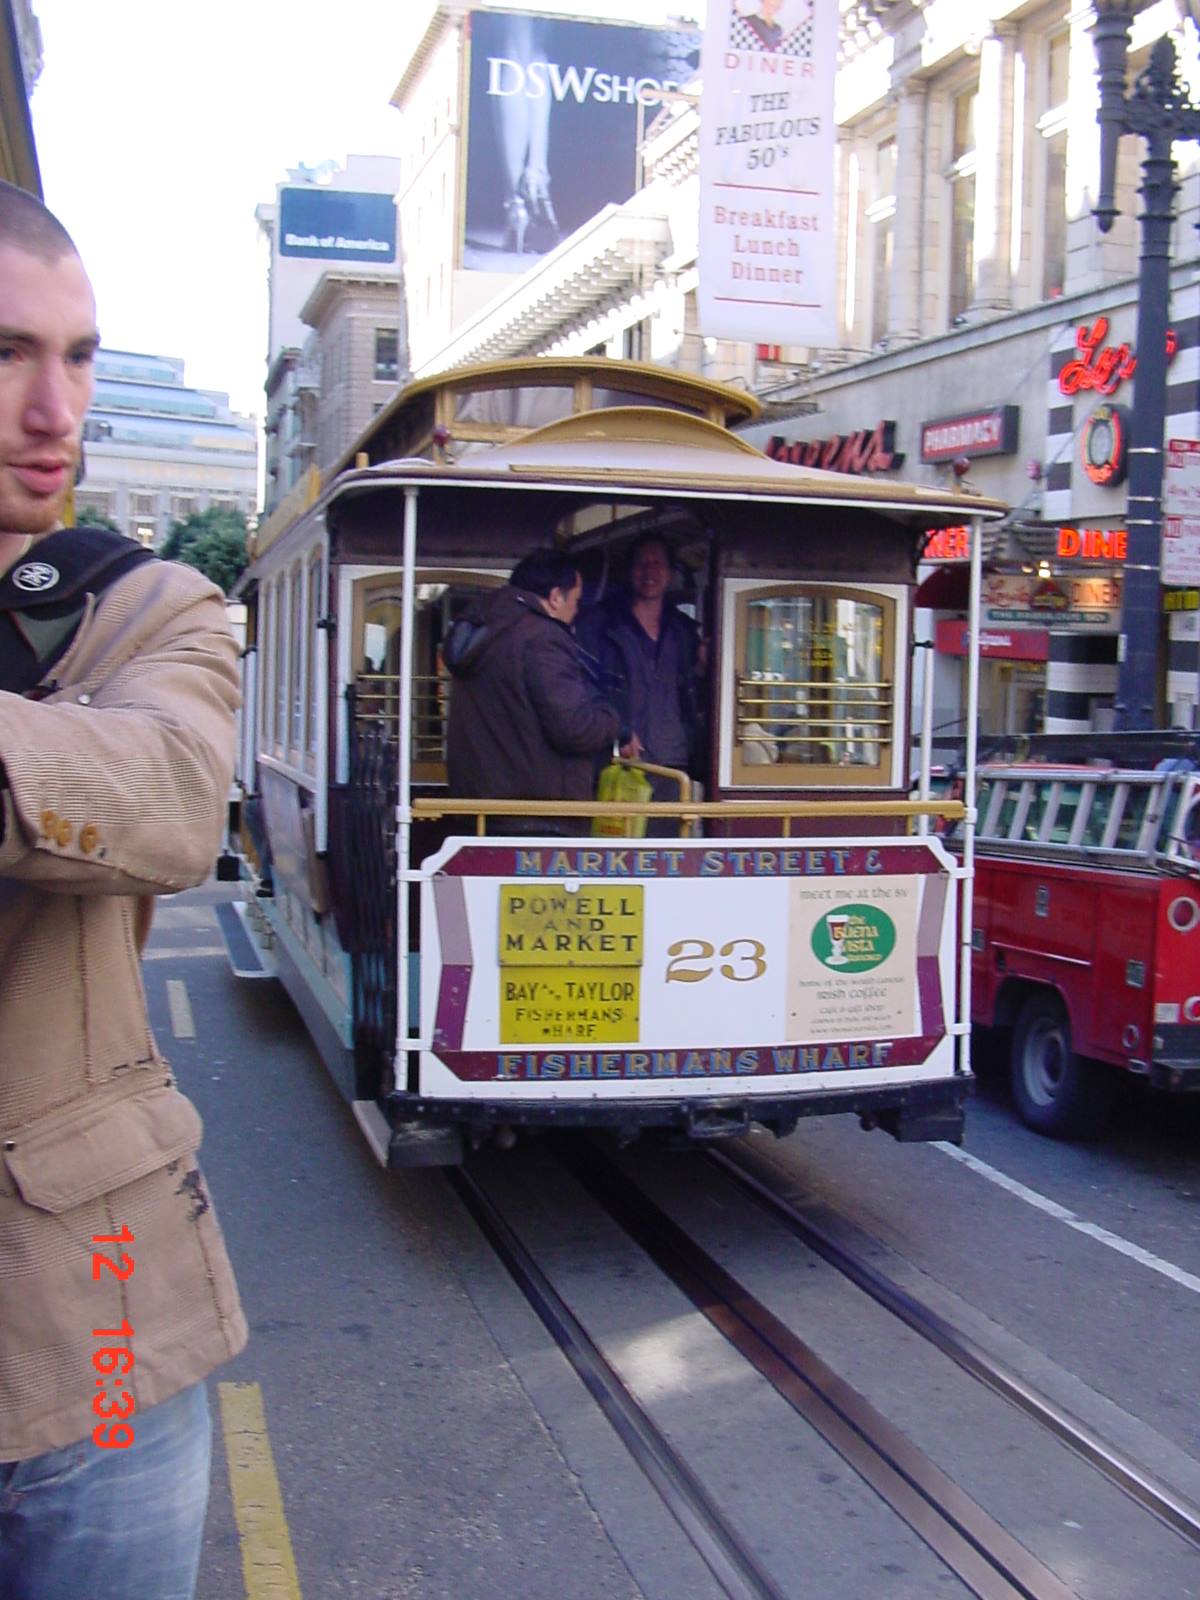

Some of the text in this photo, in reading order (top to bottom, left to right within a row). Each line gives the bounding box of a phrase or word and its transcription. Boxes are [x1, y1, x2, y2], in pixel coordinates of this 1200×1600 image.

[724, 52, 815, 78] DINER
[750, 91, 789, 113] THE
[715, 116, 820, 145] FABULOUS
[747, 145, 789, 170] 50's
[713, 205, 819, 232] Breakfast
[733, 234, 800, 257] Lunch
[731, 261, 803, 284] Dinner
[1057, 527, 1127, 559] DINE
[516, 849, 685, 876] MARKET
[701, 849, 849, 876] STREET
[509, 897, 636, 915] POWELL
[543, 918, 604, 932] AND
[506, 934, 638, 952] MARKET
[665, 938, 767, 983] 23
[505, 982, 539, 1002] BAY
[565, 982, 634, 1002] TAYLOR
[497, 1043, 893, 1079] FISHERMANS WHARF
